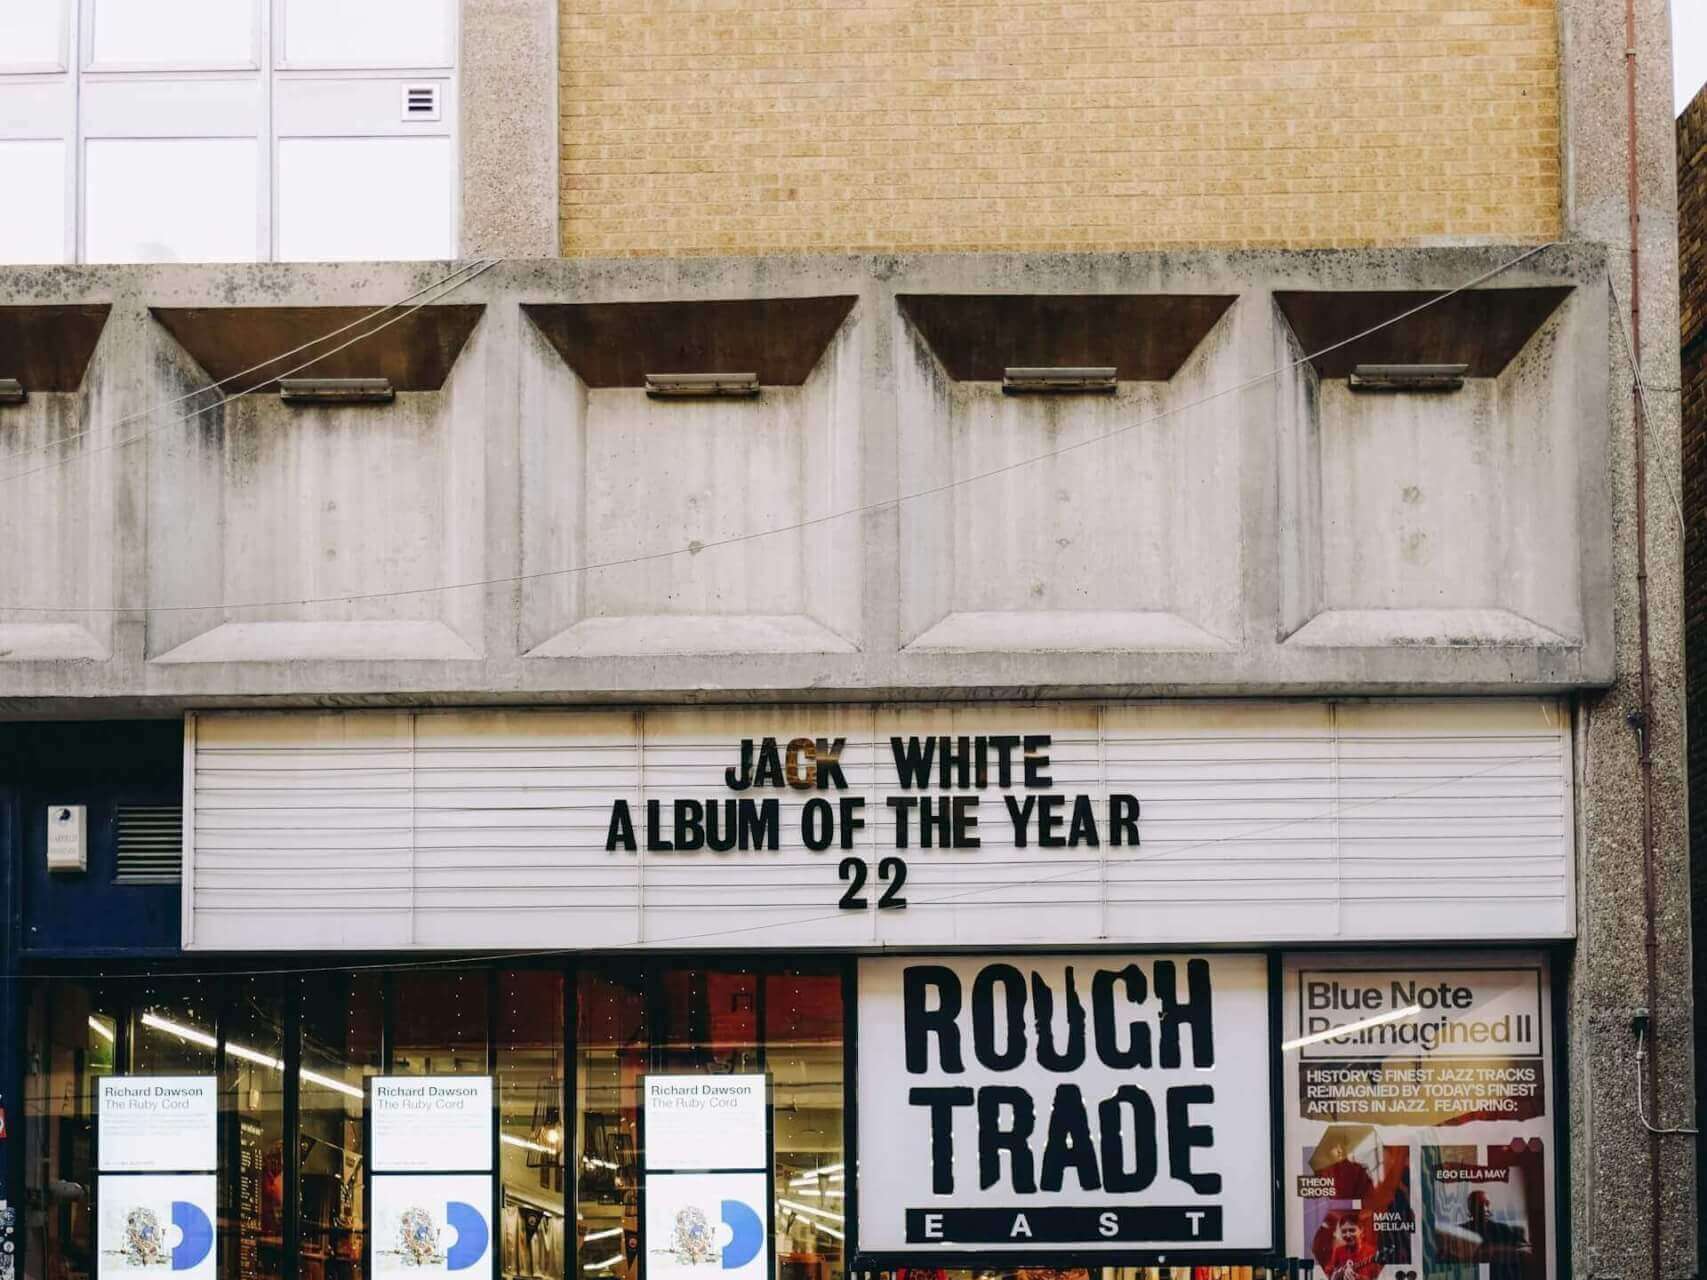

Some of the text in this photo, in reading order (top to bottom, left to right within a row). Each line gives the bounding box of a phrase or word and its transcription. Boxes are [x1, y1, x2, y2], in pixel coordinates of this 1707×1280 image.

[725, 734, 1053, 790] JACK WHITE
[606, 795, 1141, 851] ALBUM OF THE YEAR
[838, 857, 908, 910] 22
[1307, 980, 1473, 1010] Blue Note
[903, 958, 1215, 1075] ROUGH
[1306, 1067, 1536, 1083] HISTORY'S FINEST JAZZ TRACKS
[105, 1086, 204, 1097] Richard Dawson
[377, 1086, 478, 1097] Richard Dawson
[651, 1084, 751, 1096] Richard Dawson
[1402, 1084, 1423, 1099] BY
[1424, 1083, 1485, 1098] TODAY'S
[1487, 1083, 1537, 1097] FINEST
[105, 1099, 190, 1111] The Ruby Cord
[377, 1099, 464, 1111] The Ruby Cord
[651, 1097, 738, 1110] The Ruby Cord
[1306, 1098, 1519, 1115] ARTISTS IN JAZZ. FEATURING:
[908, 1083, 1222, 1197] TRADE
[1436, 1168, 1507, 1179] EGO ELLA MAY
[1300, 1177, 1335, 1187] THEON
[1300, 1187, 1336, 1197] CROSS
[1373, 1211, 1402, 1222] MAYA
[924, 1211, 1205, 1239] EAST
[1373, 1222, 1415, 1231] DELILAH
